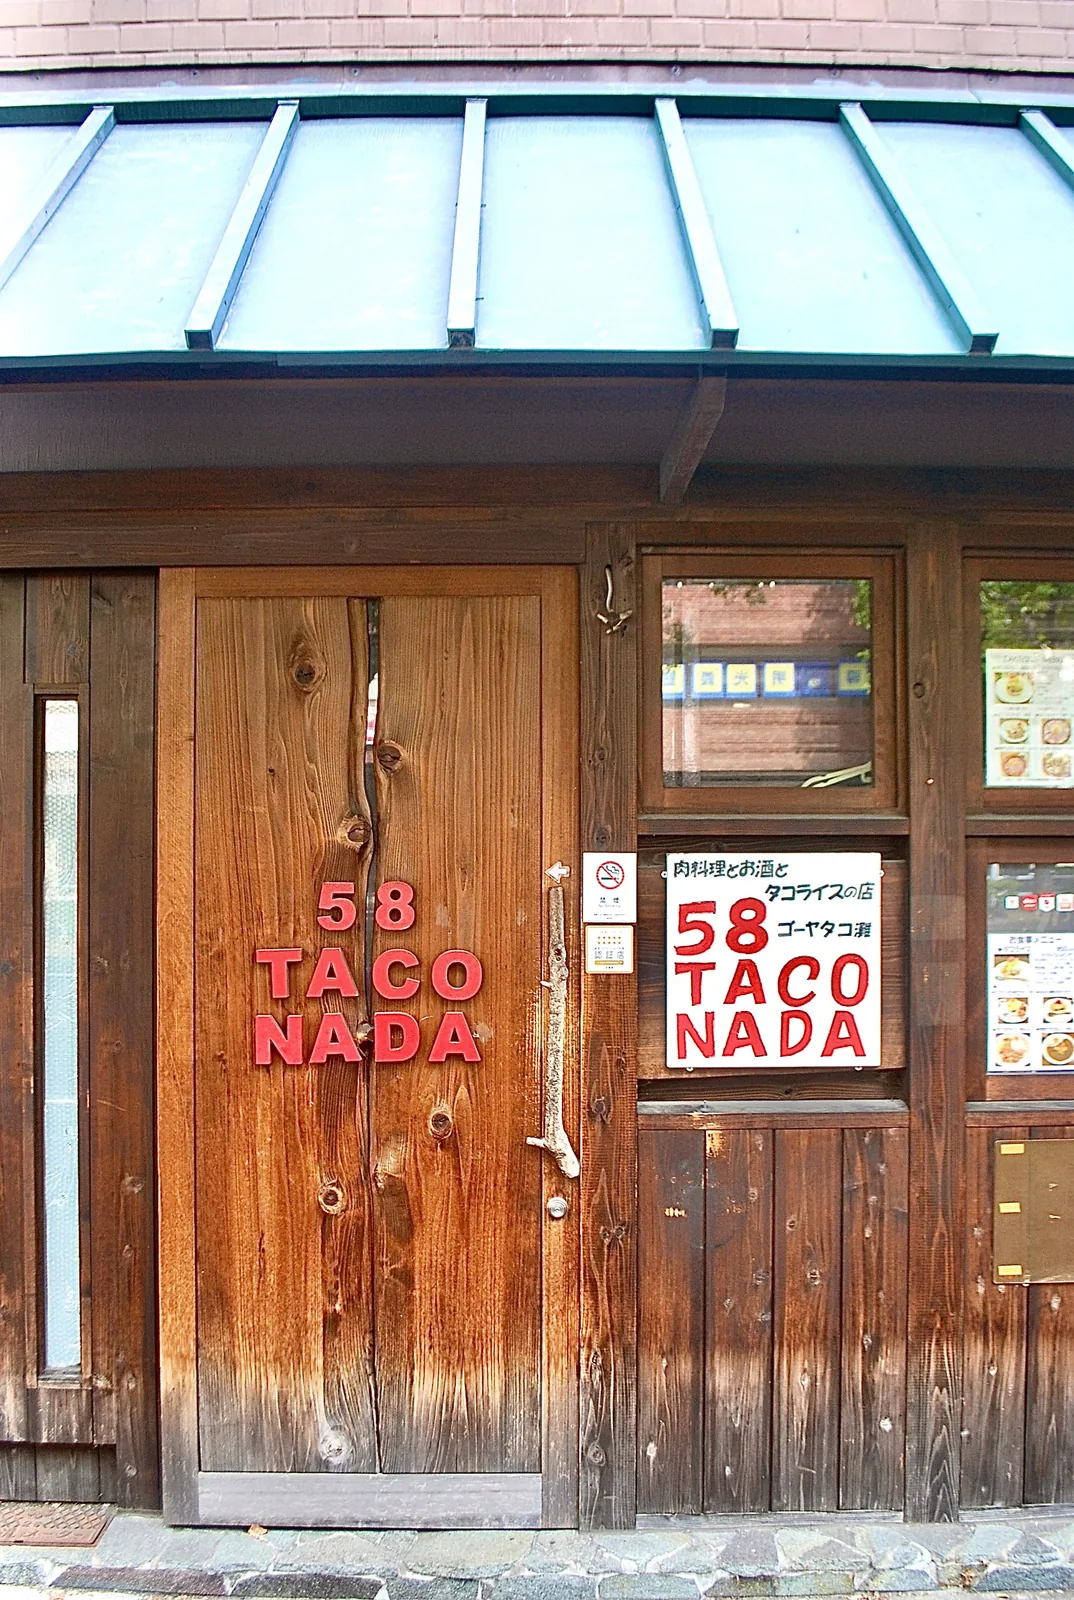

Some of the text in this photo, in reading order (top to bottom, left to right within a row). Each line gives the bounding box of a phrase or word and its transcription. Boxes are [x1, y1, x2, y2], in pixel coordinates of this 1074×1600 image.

[673, 859, 789, 879] 肉料理とお酒と
[764, 882, 875, 902] タコライスの店
[316, 881, 415, 931] 58
[673, 897, 769, 956] 58
[777, 920, 872, 938] ゴーヤタコ灘
[255, 947, 483, 1001] TACO
[674, 953, 869, 1007] TACO
[255, 1011, 482, 1065] NADA
[675, 1010, 867, 1060] NADA
